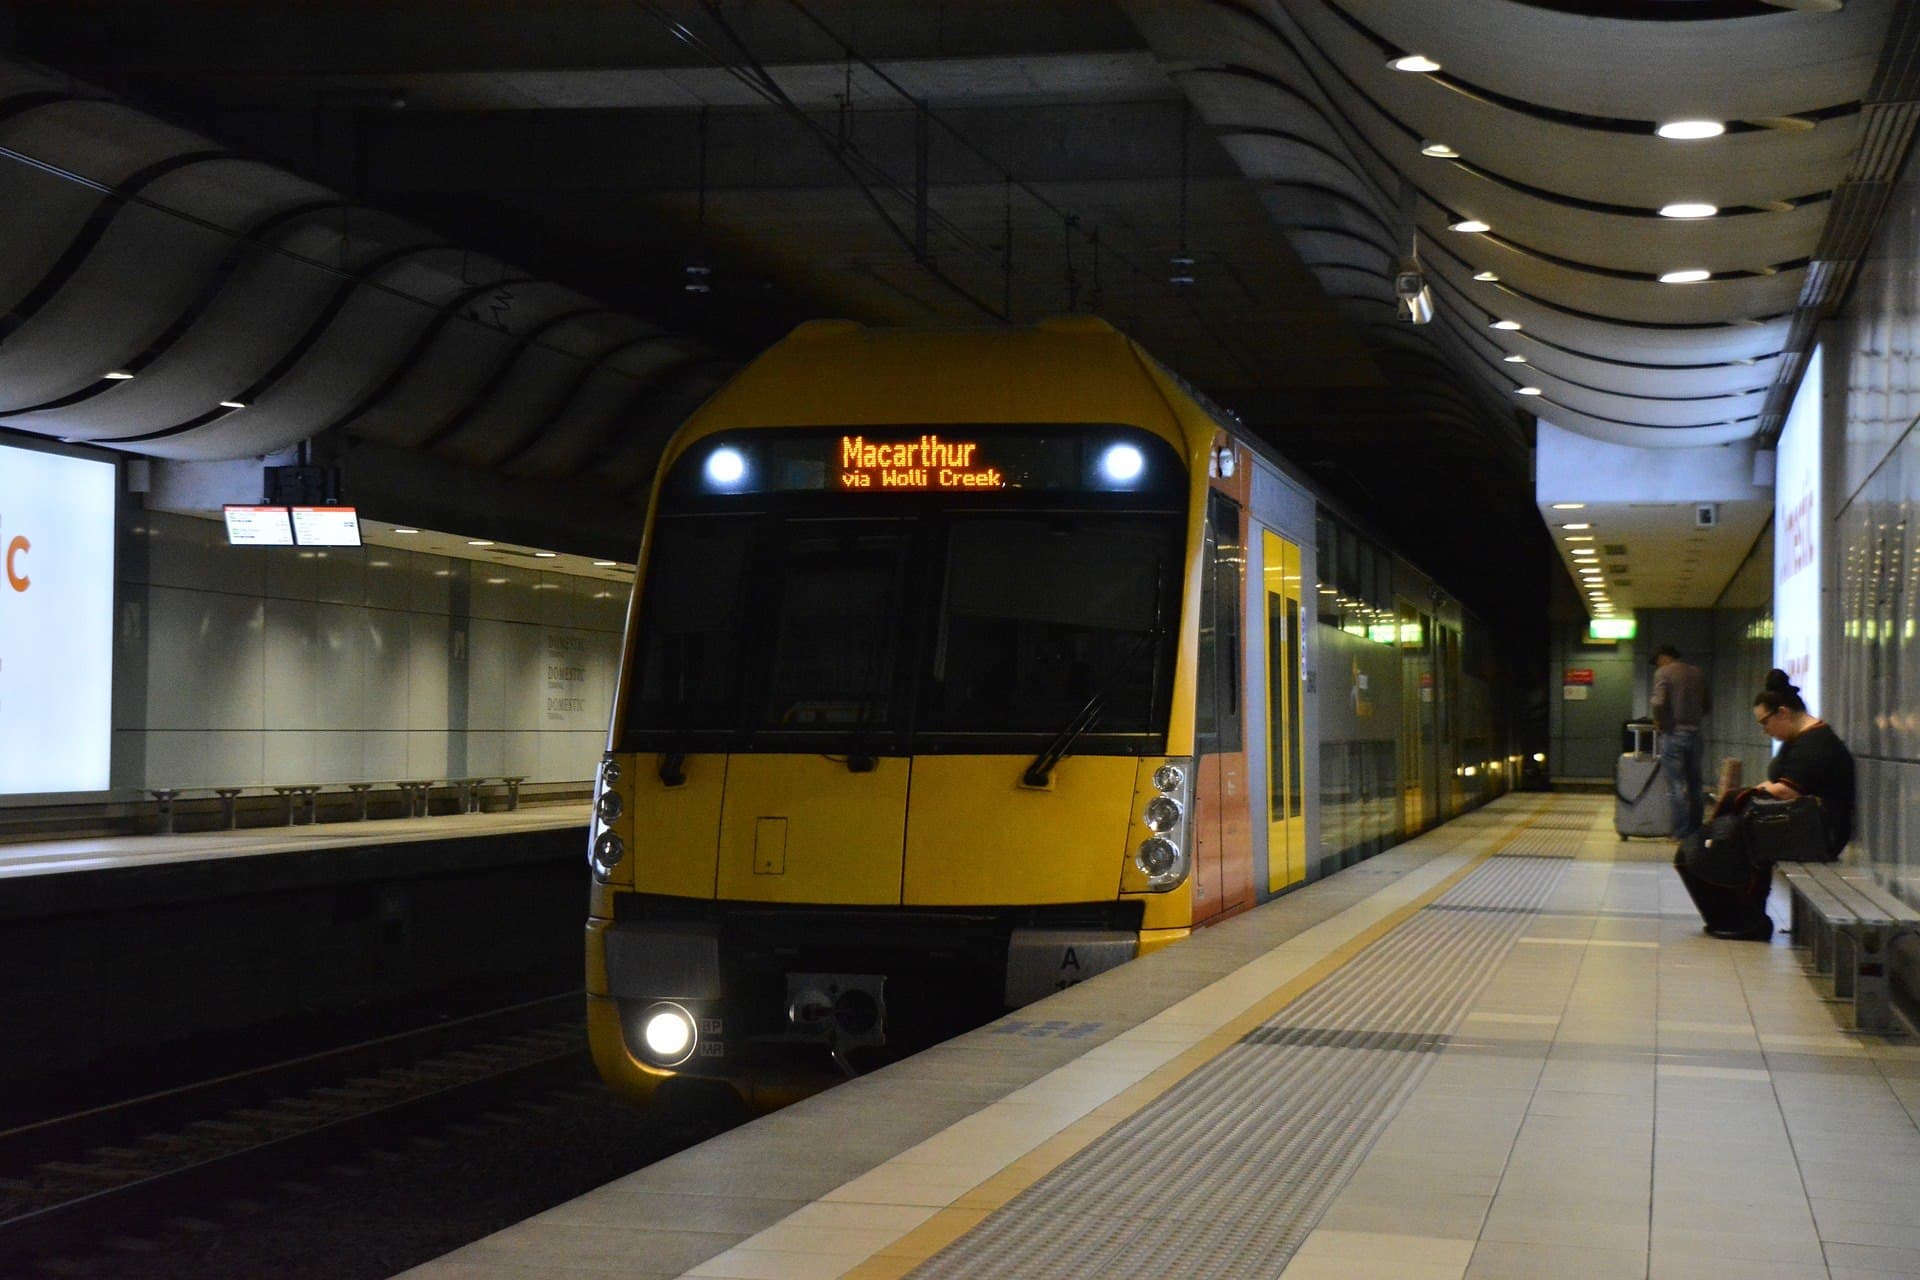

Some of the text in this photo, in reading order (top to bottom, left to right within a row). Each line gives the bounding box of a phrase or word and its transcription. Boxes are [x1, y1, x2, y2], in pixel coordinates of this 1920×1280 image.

[842, 435, 976, 468] Macarthur
[842, 469, 1001, 487] via Wolli Creek
[547, 665, 585, 682] DOMESTIC
[547, 697, 585, 712] DOMESTIC
[1061, 946, 1080, 969] A
